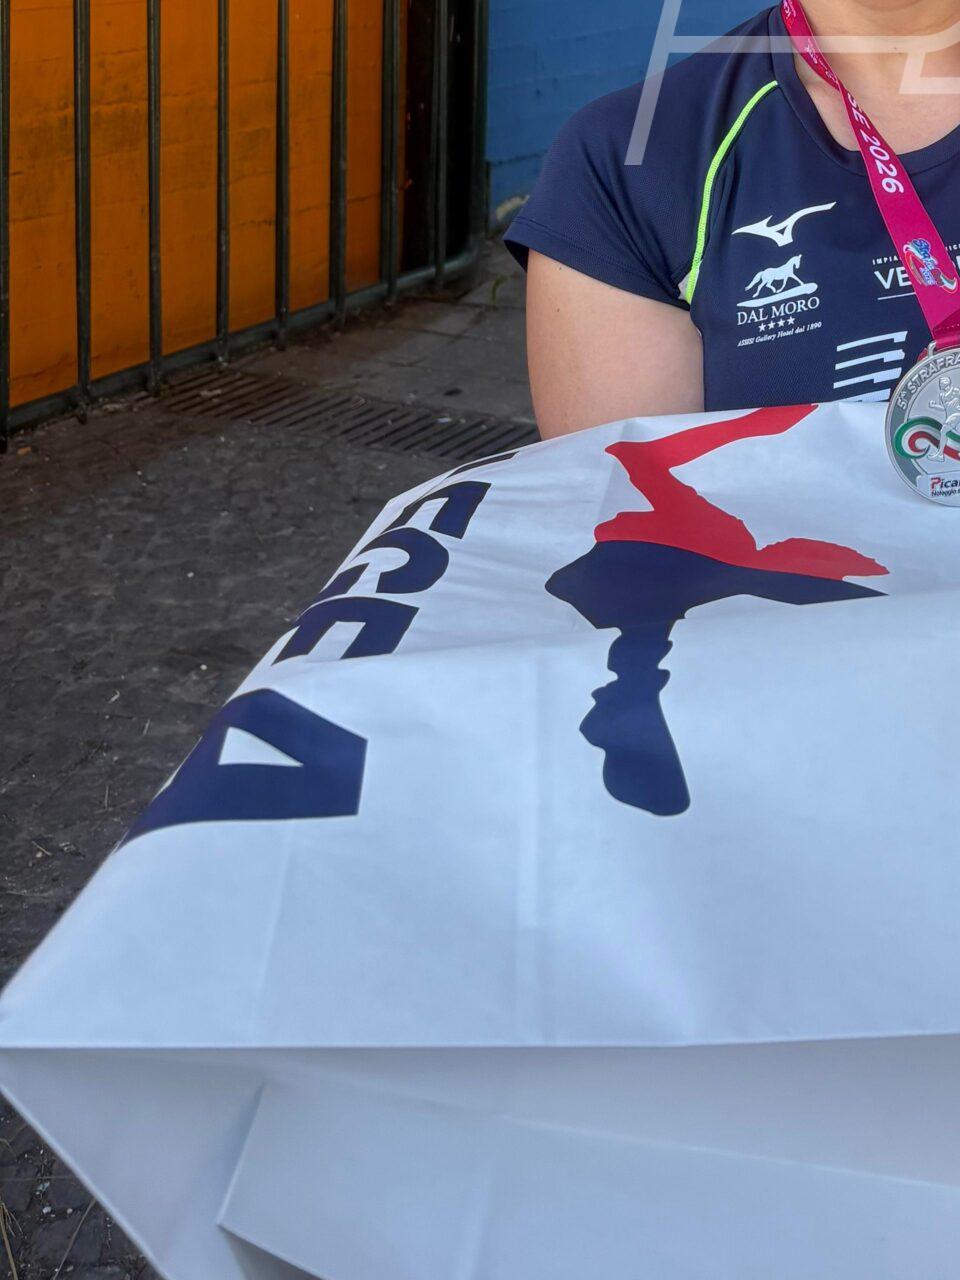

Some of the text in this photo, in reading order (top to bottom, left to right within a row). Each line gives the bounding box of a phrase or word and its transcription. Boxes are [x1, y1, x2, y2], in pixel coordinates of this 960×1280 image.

[861, 129, 905, 194] 2026
[737, 296, 820, 326] DAL MORO
